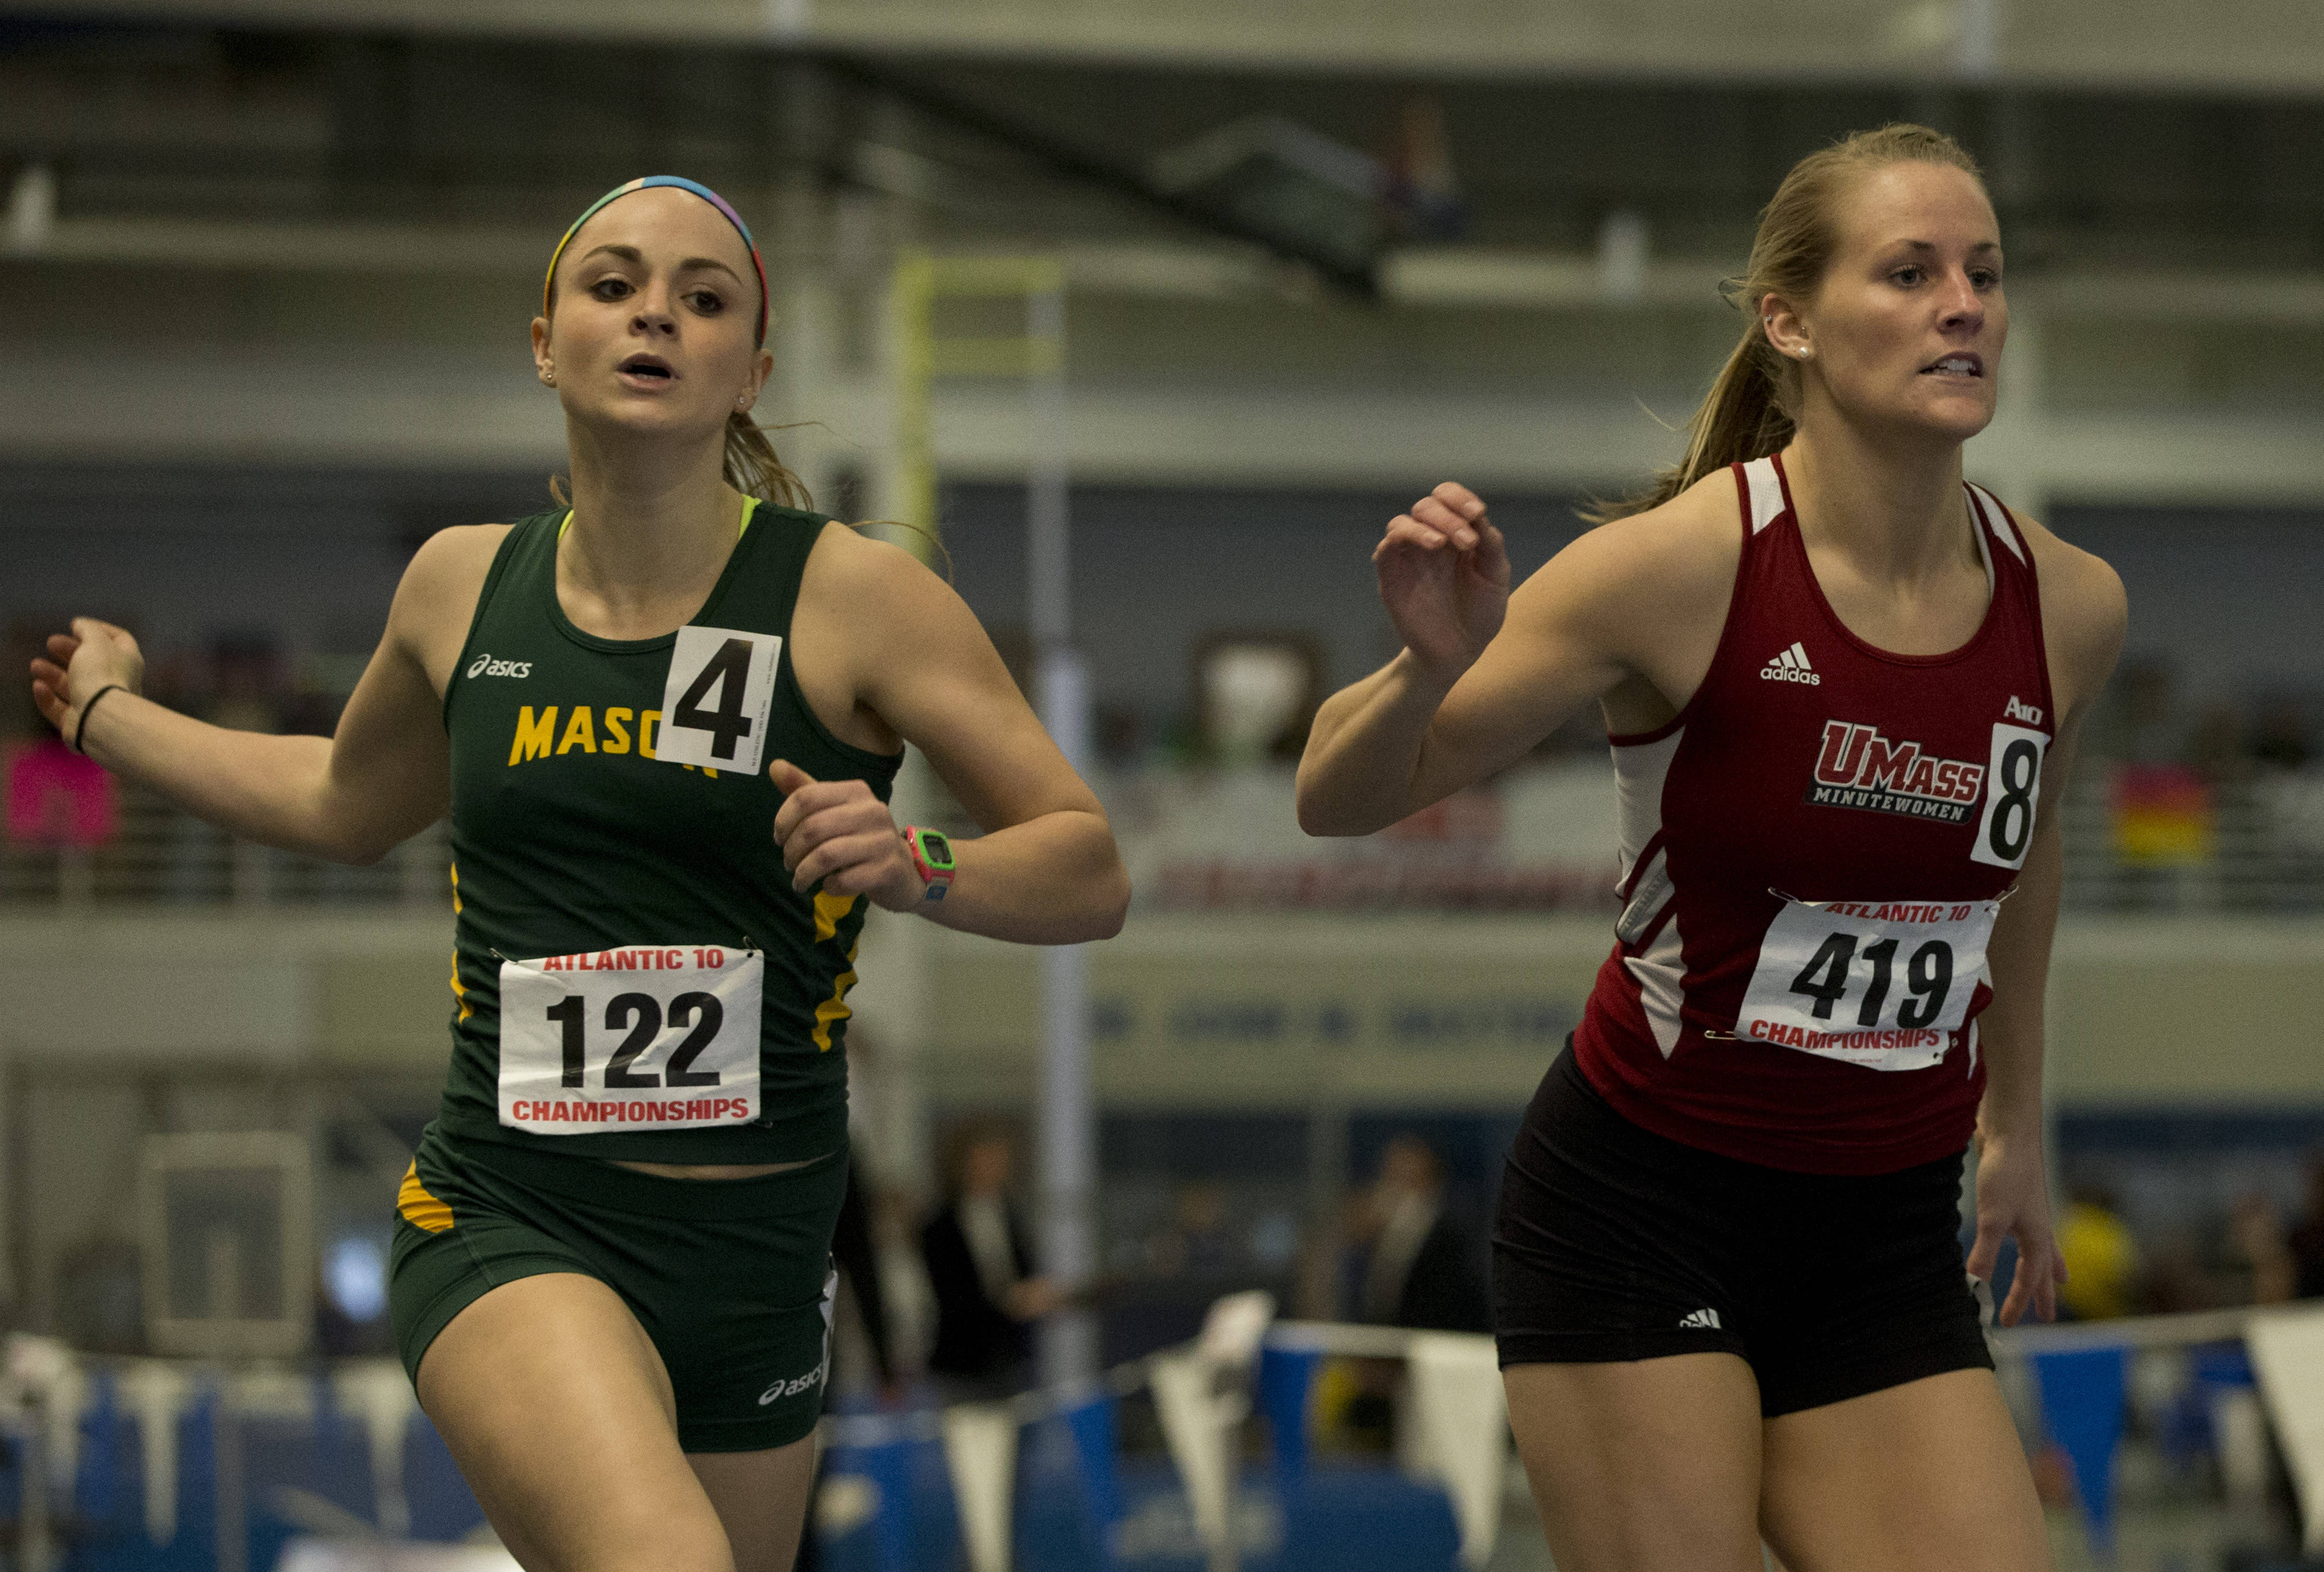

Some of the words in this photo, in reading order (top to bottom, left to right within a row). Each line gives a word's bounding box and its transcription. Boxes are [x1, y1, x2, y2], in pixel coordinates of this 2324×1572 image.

[486, 659, 533, 678] asics
[1760, 665, 1821, 686] adidas
[672, 637, 754, 761] 4
[508, 705, 718, 779] MASO
[1813, 787, 1965, 821] MINUTEWOMEN
[1989, 738, 2038, 861] 8
[1825, 902, 1944, 924] ATLANTIC
[1948, 905, 1971, 921] 10
[544, 949, 683, 971] ATLANTIC
[692, 949, 724, 969] 10
[1788, 931, 1954, 1030] 419
[547, 991, 724, 1089] 122
[1749, 1019, 1940, 1049] CHAMPIONSHIPS
[512, 1097, 748, 1122] CHAMPIONSHIPS
[785, 1363, 822, 1396] asic
